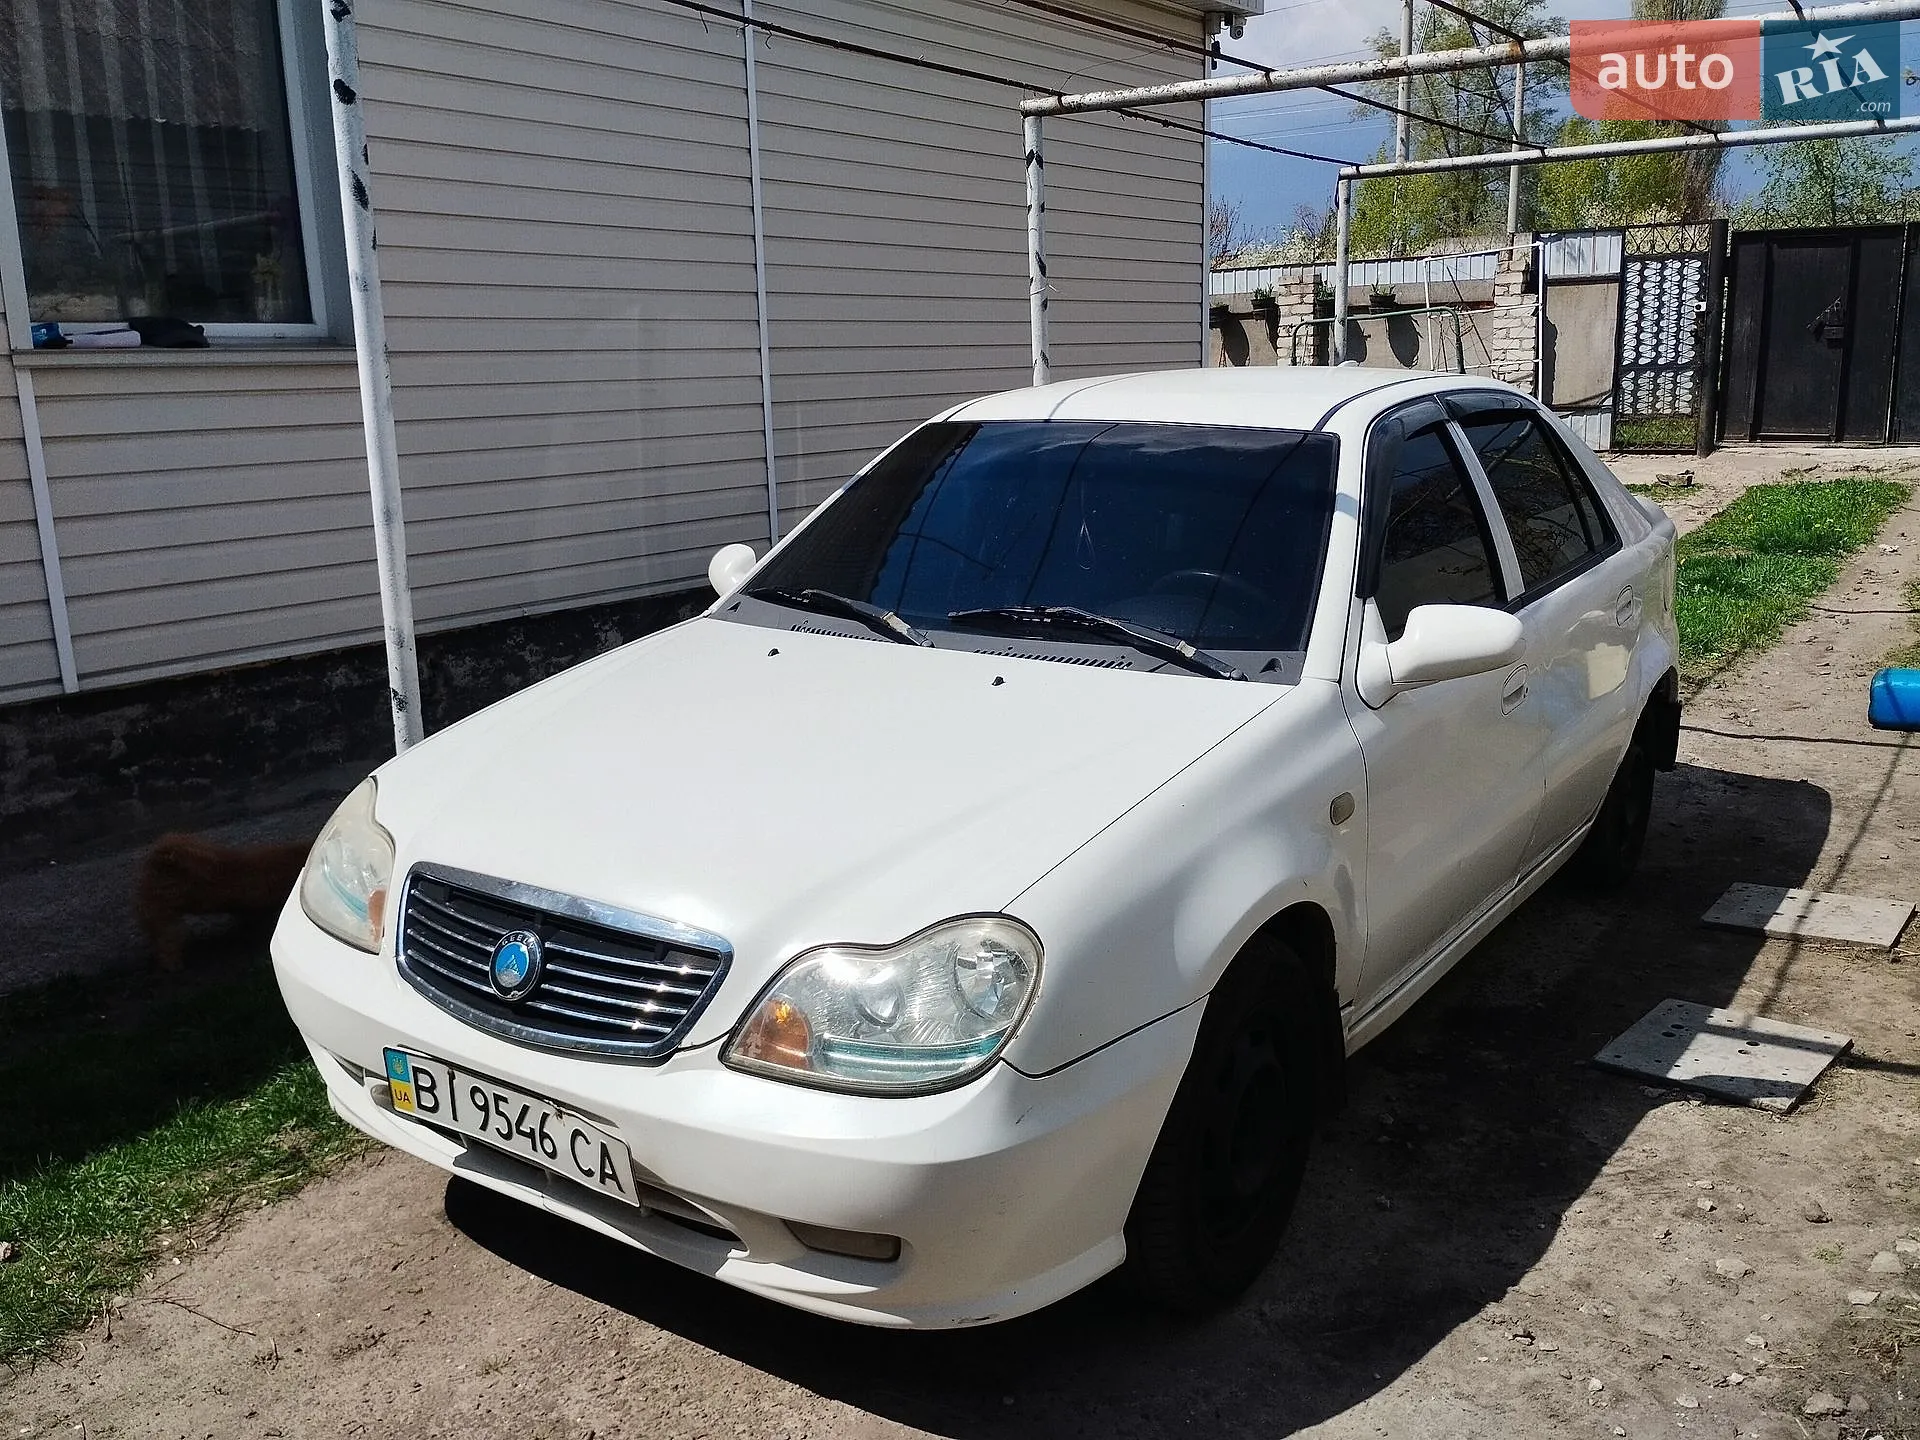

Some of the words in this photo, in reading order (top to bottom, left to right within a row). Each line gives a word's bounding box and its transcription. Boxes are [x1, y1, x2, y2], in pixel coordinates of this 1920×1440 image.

[394, 1091, 411, 1104] UA
[469, 1085, 558, 1160] 9546
[570, 1128, 626, 1194] CA
